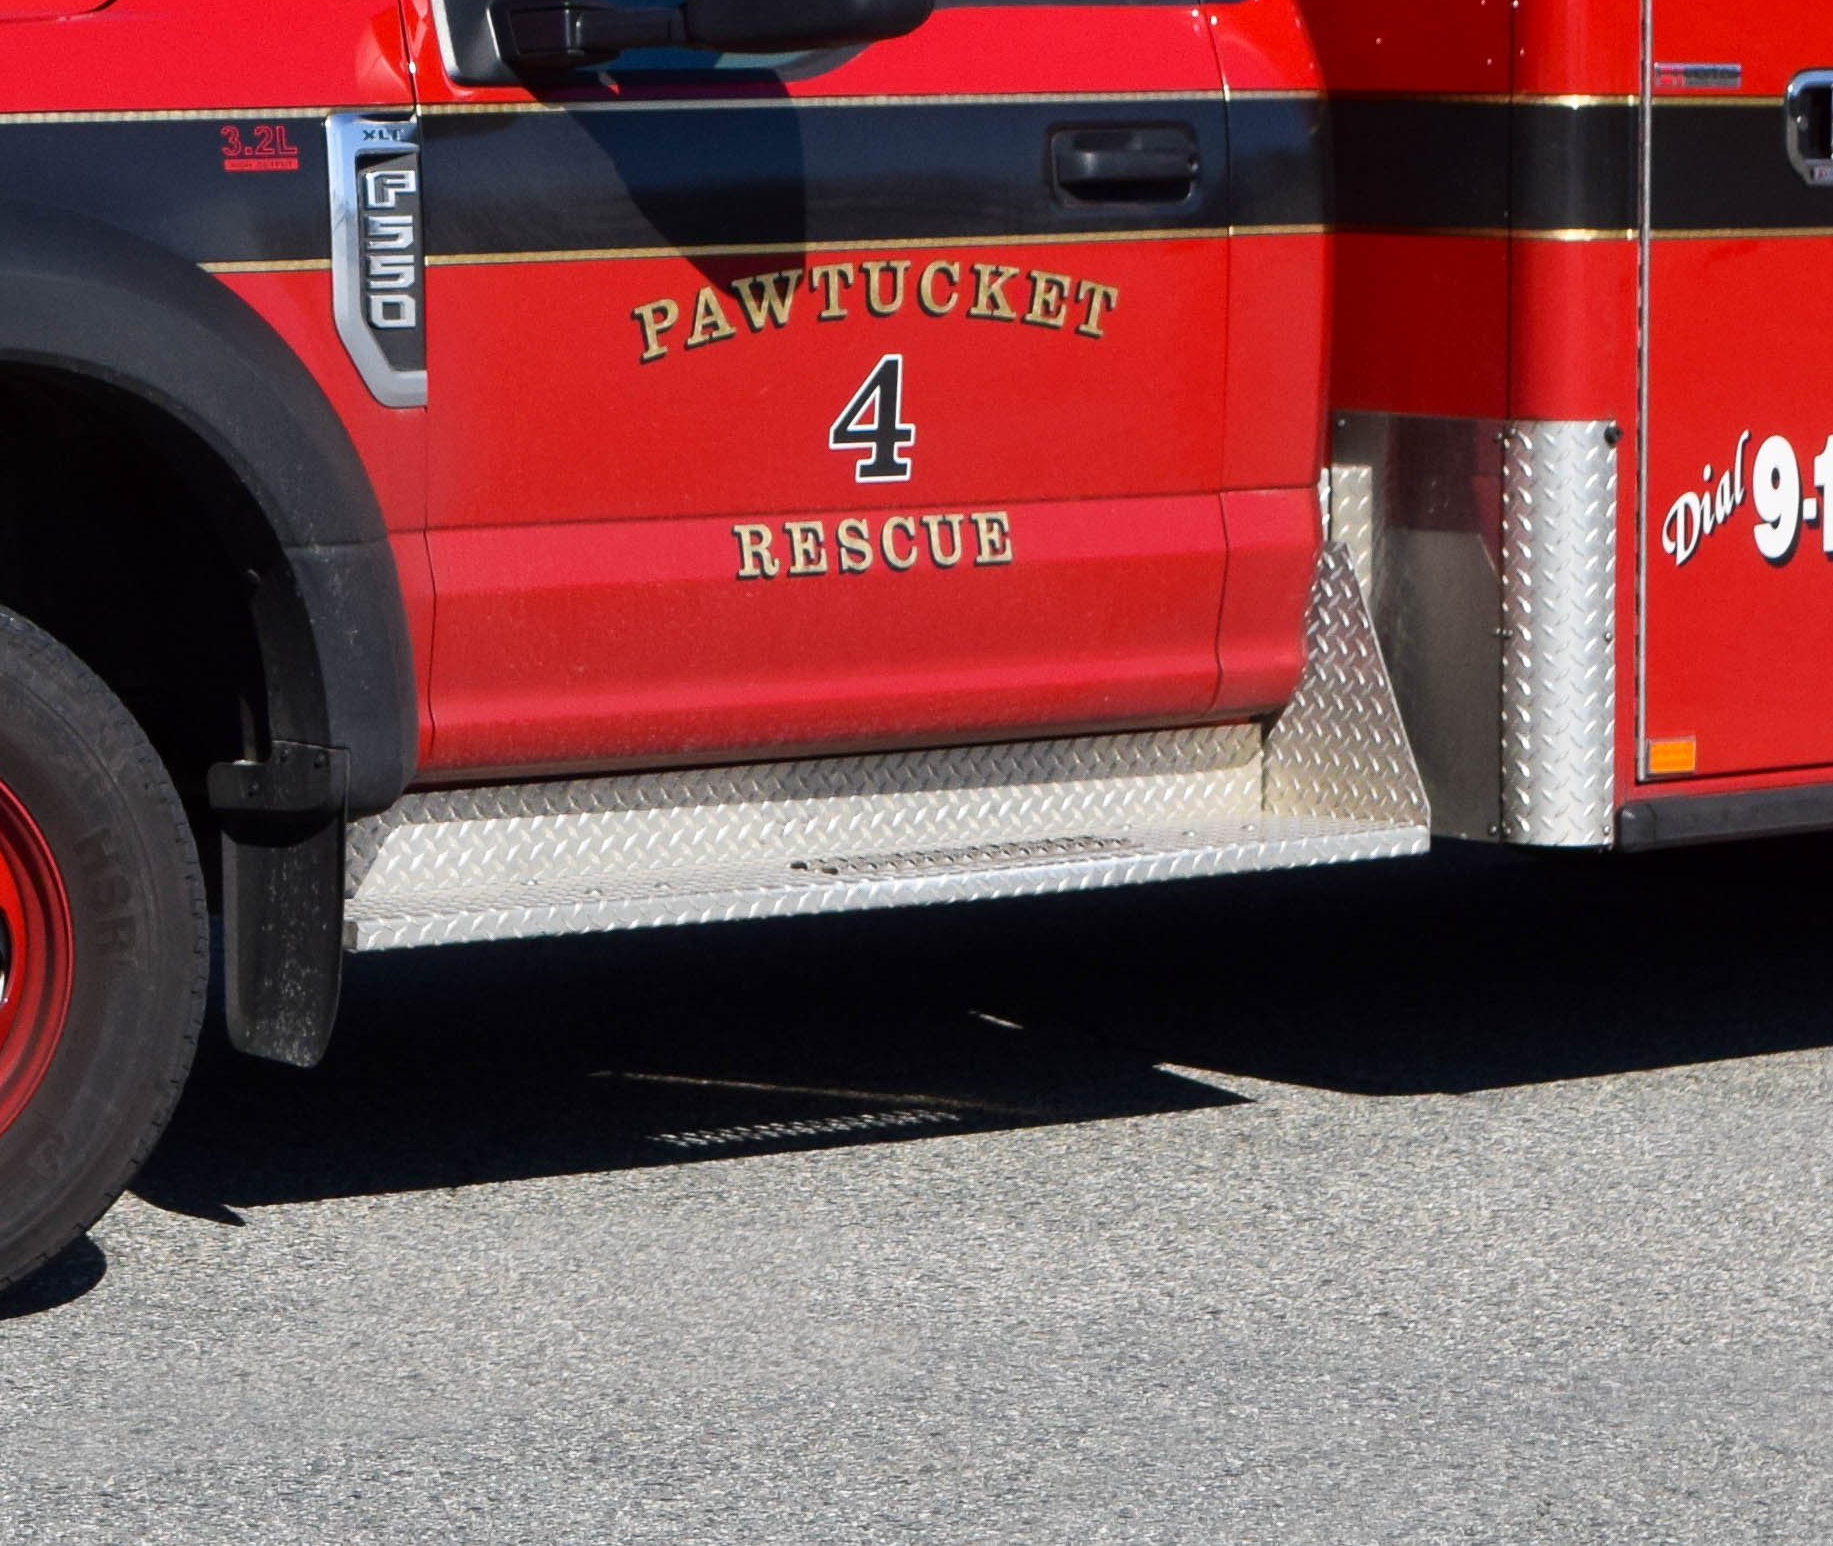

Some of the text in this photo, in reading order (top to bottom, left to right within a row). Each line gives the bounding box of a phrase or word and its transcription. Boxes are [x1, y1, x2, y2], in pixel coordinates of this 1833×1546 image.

[220, 125, 298, 156] 3.2L
[362, 128, 404, 141] XLT
[632, 259, 1119, 364] PAWTUCKET
[828, 353, 915, 483] 4
[1661, 429, 1751, 566] Dial
[733, 510, 1013, 580] RESCUE
